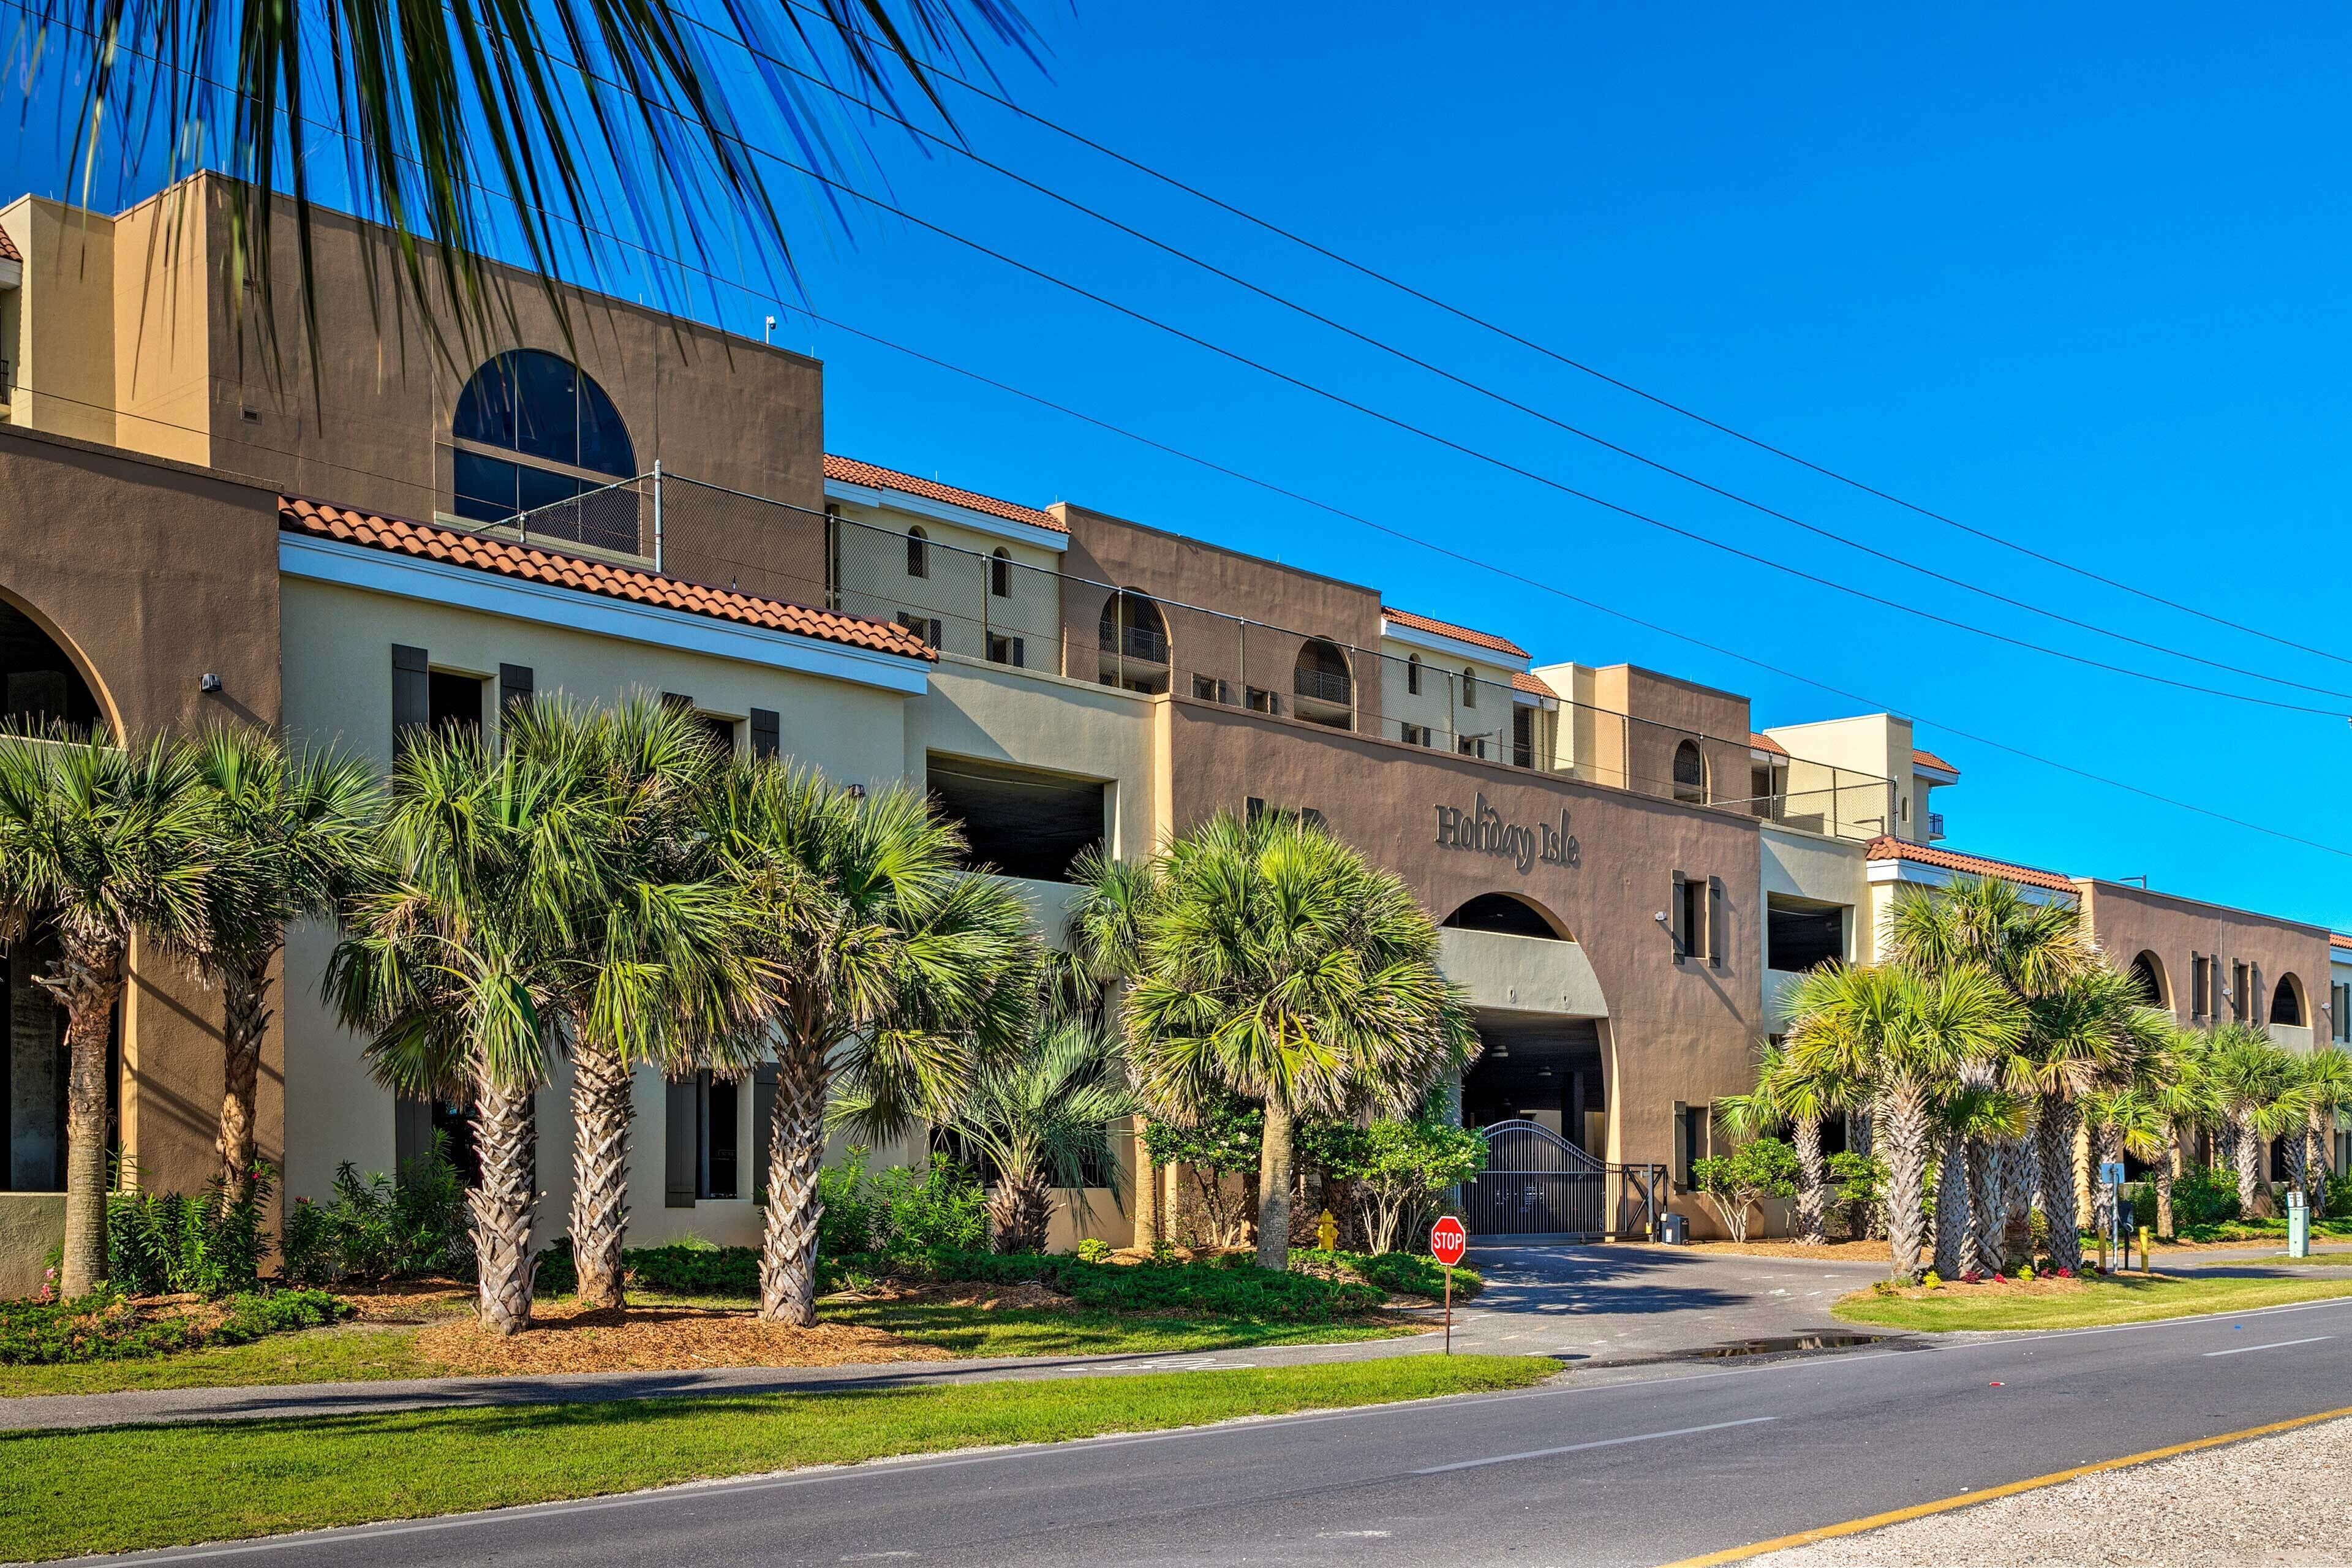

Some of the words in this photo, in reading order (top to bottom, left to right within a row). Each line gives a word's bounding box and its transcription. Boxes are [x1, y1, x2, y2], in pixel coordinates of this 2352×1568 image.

[1433, 791, 1531, 869] Holiday
[1537, 808, 1578, 863] Isle
[1434, 1231, 1463, 1250] STOP
